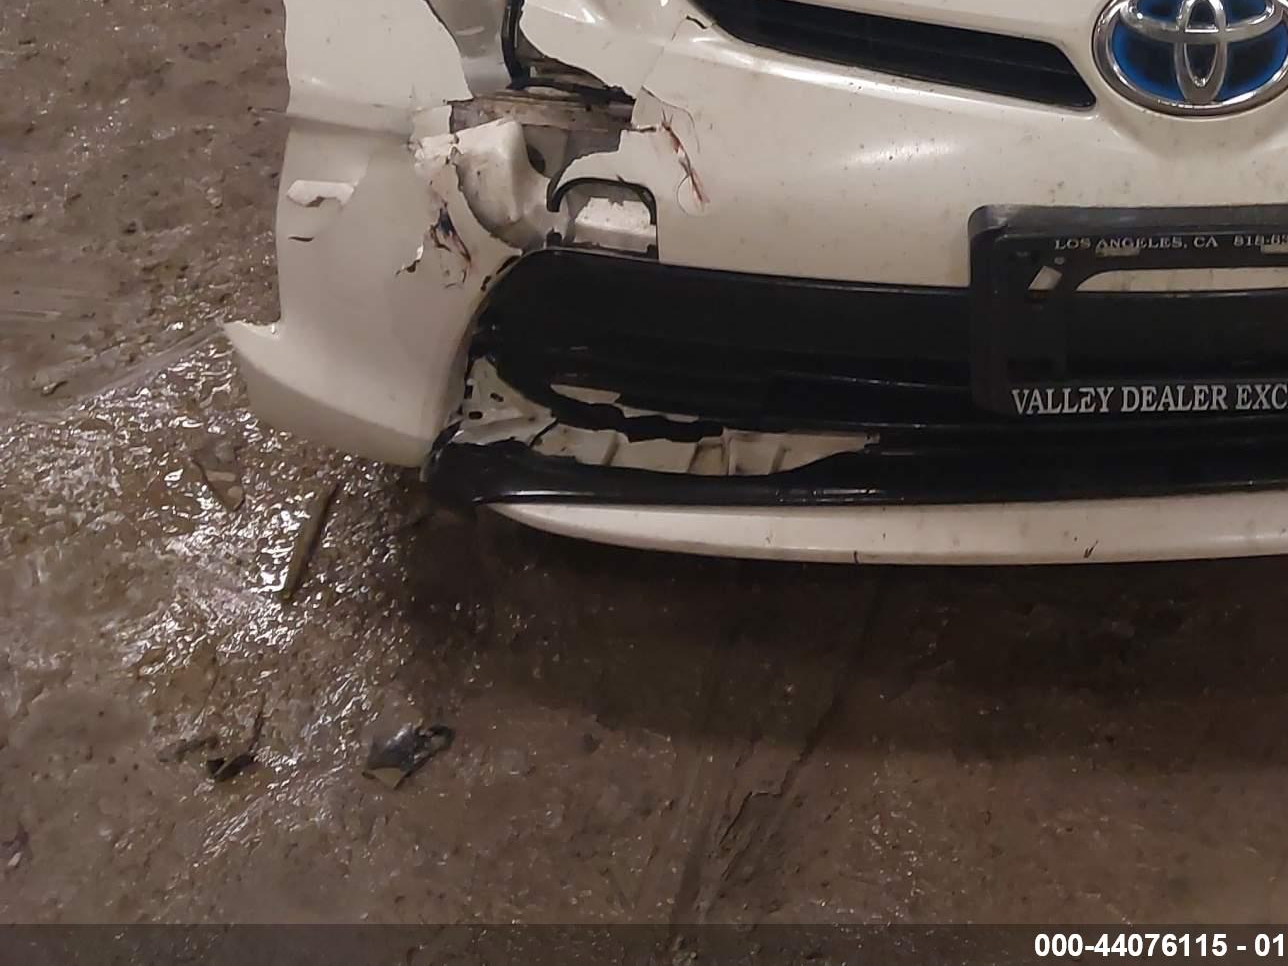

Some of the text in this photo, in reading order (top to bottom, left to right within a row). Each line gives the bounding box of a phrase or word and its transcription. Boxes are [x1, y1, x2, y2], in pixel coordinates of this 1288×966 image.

[1055, 238, 1091, 250] LOS
[1193, 237, 1219, 249] CA
[1011, 387, 1114, 415] VALLEY
[1120, 384, 1228, 413] DEALER
